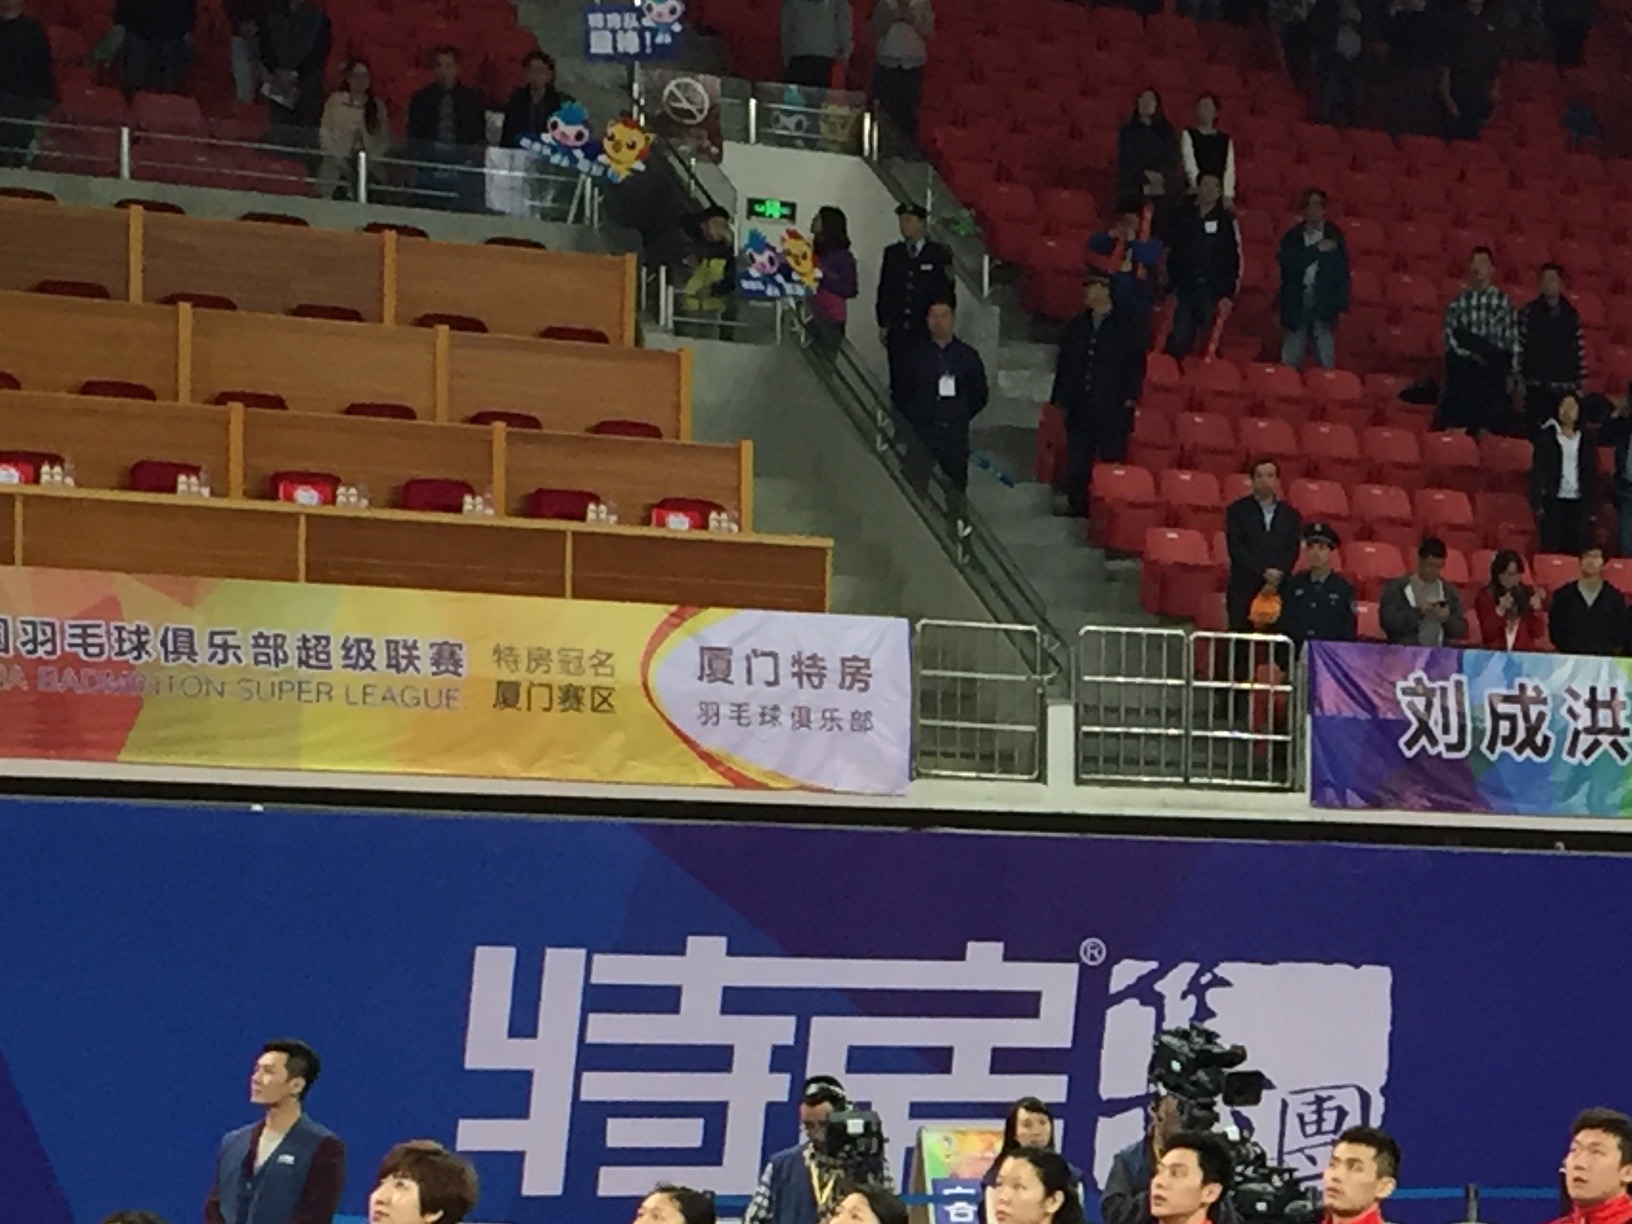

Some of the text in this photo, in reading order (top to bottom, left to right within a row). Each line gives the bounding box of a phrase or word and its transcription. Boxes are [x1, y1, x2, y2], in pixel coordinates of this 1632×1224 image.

[491, 643, 616, 677] 特房冠名
[697, 646, 873, 693] 厦门特房
[37, 665, 226, 700] BADMINTON
[238, 677, 333, 704] SUPER
[345, 684, 460, 711] LEAGUE
[491, 681, 617, 714] 厦门赛区
[697, 702, 874, 733] 羽毛球俱乐部
